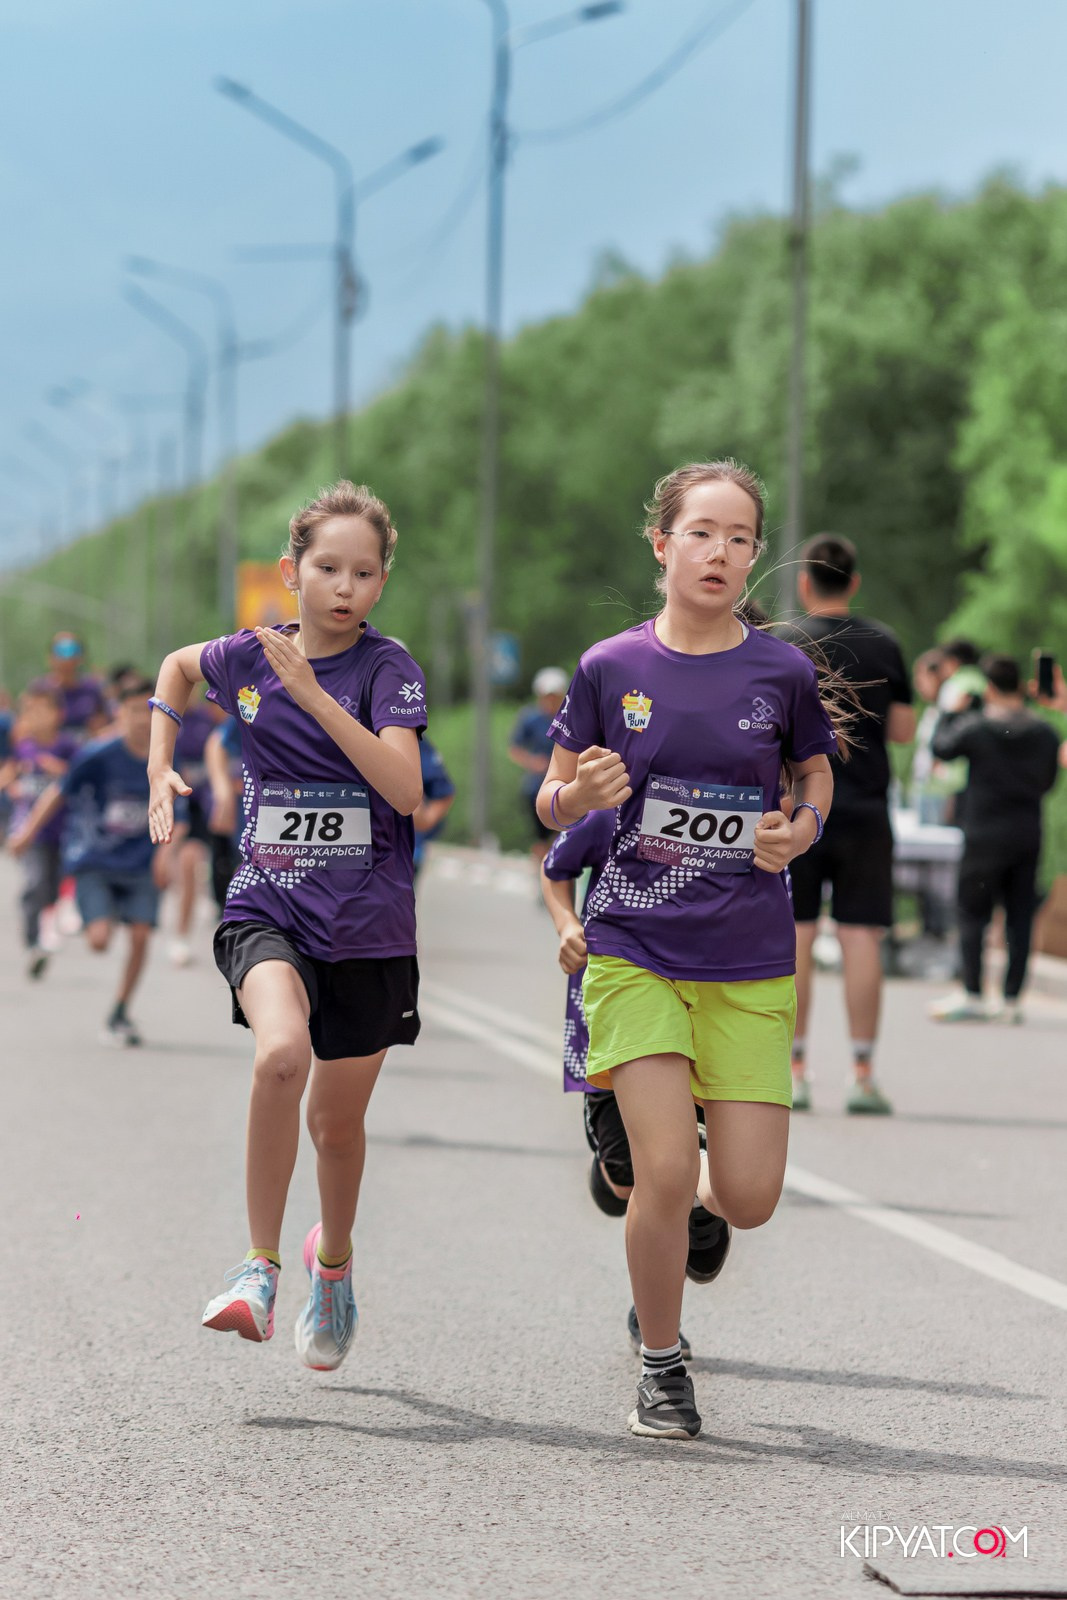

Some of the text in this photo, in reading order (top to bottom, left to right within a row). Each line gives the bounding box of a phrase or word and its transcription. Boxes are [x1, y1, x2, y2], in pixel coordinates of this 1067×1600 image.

[389, 705, 421, 715] Dream
[627, 713, 636, 721] BI
[629, 718, 646, 727] RUN
[751, 721, 774, 730] GROUP
[279, 811, 344, 842] 218
[660, 807, 744, 845] 200
[257, 845, 367, 857] БАЛАЛАР ЖАРЫСЫ
[643, 836, 753, 860] БАЛАЛАР ЖАРЫСЫ
[293, 858, 316, 868] 600
[681, 856, 706, 867] 600
